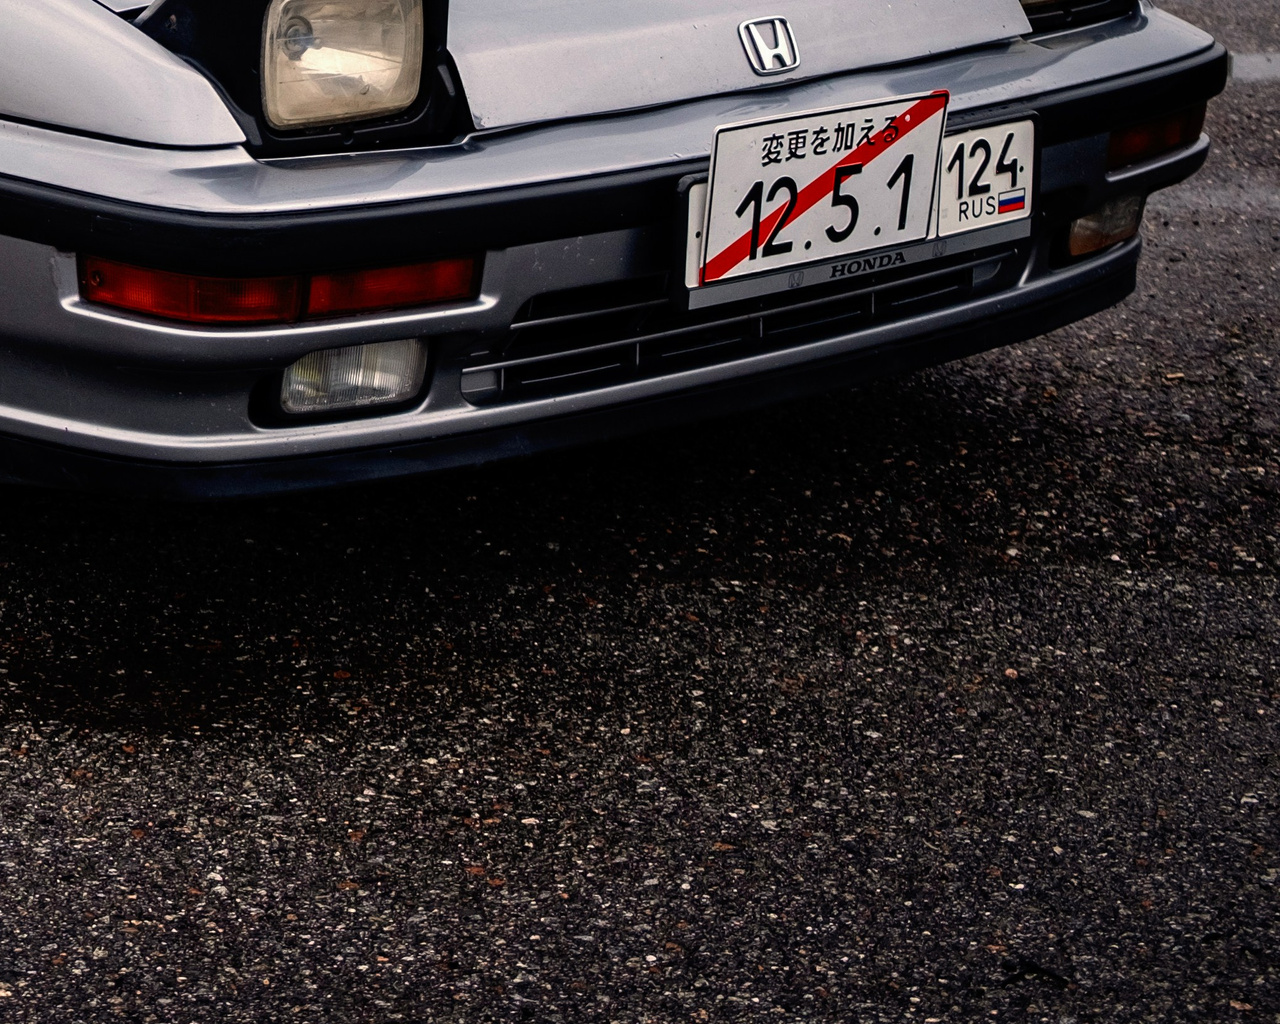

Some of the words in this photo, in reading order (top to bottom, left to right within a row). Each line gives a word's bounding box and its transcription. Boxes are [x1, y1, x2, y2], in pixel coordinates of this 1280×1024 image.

[761, 116, 901, 167] 変更を加える
[945, 132, 1020, 200] 124
[735, 153, 915, 261] 12.5.1
[958, 197, 996, 222] RUS
[829, 251, 907, 278] HONDA
